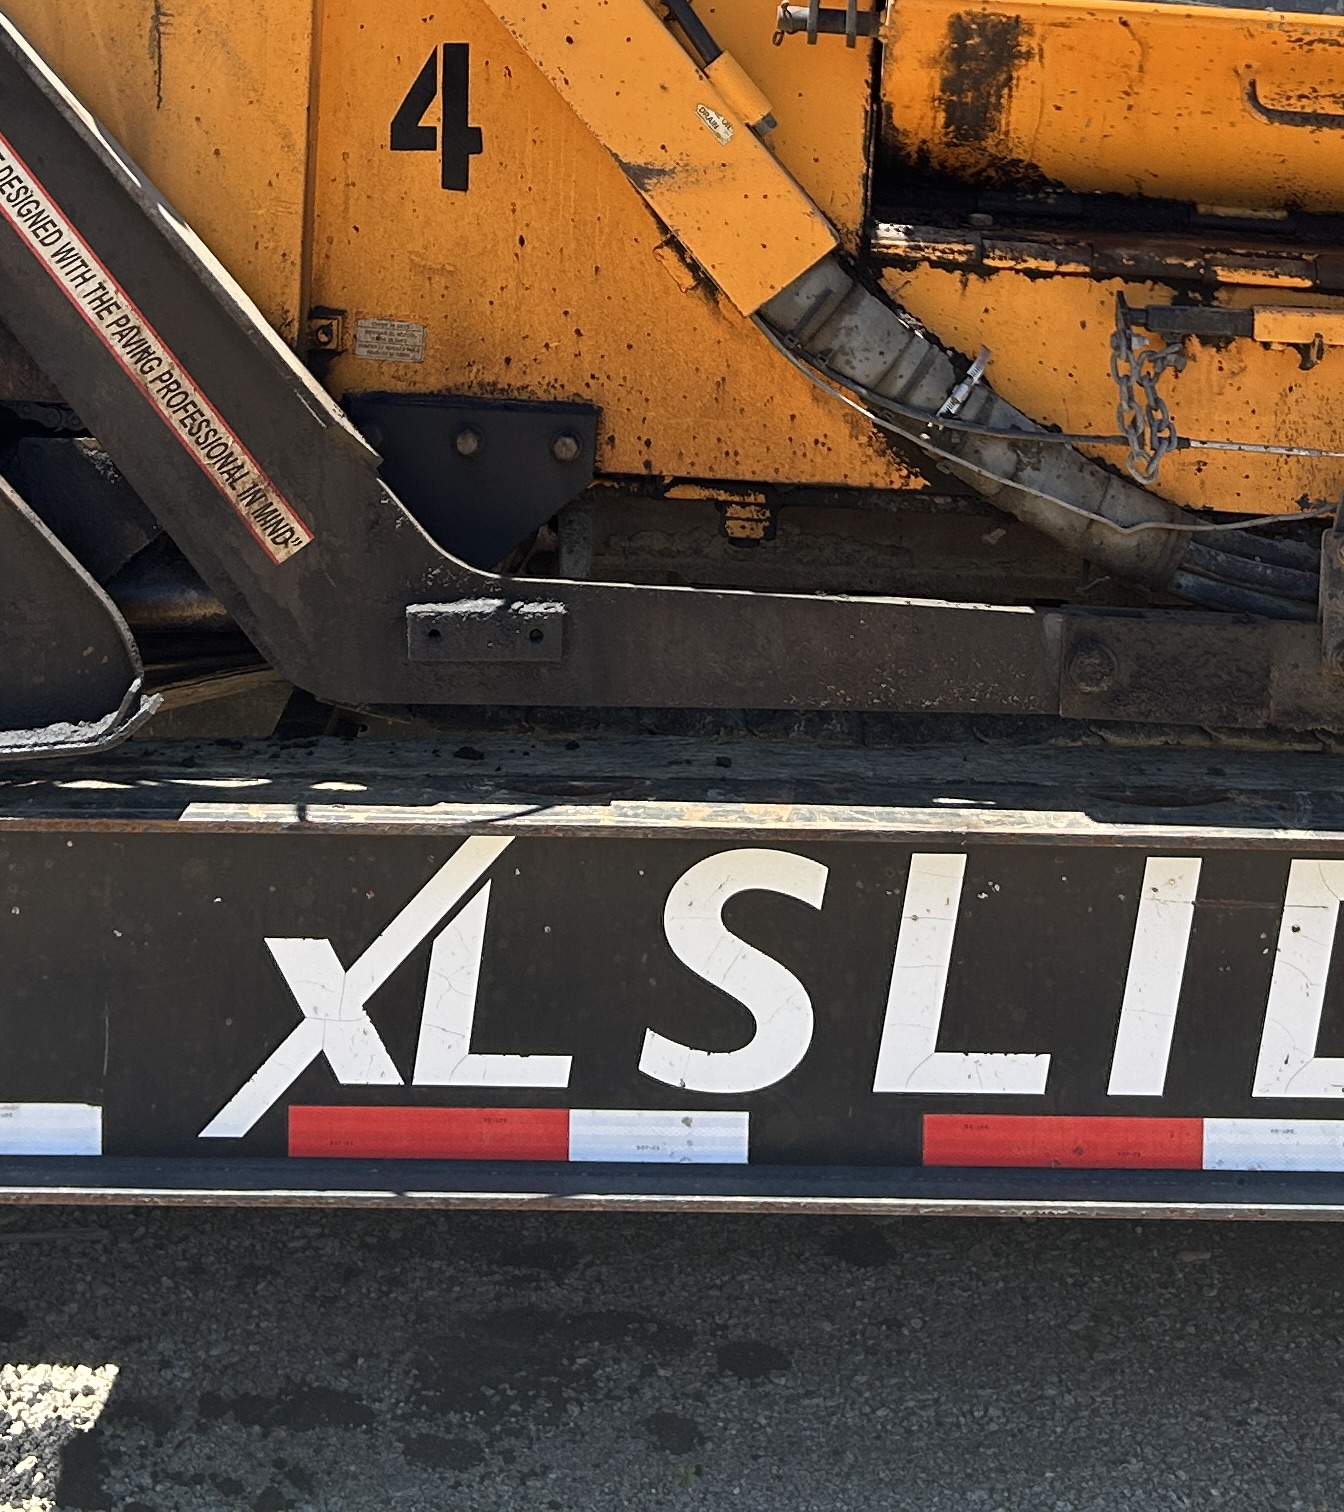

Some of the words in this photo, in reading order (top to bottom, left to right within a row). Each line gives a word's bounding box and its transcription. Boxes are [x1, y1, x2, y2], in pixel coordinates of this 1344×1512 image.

[390, 42, 483, 193] 4
[698, 106, 719, 130] DRAIN
[50, 241, 96, 289] WITH
[82, 281, 121, 321] THE
[105, 314, 163, 376] PAVING
[148, 369, 250, 491] PROFESSIONAL
[236, 483, 264, 508] IN
